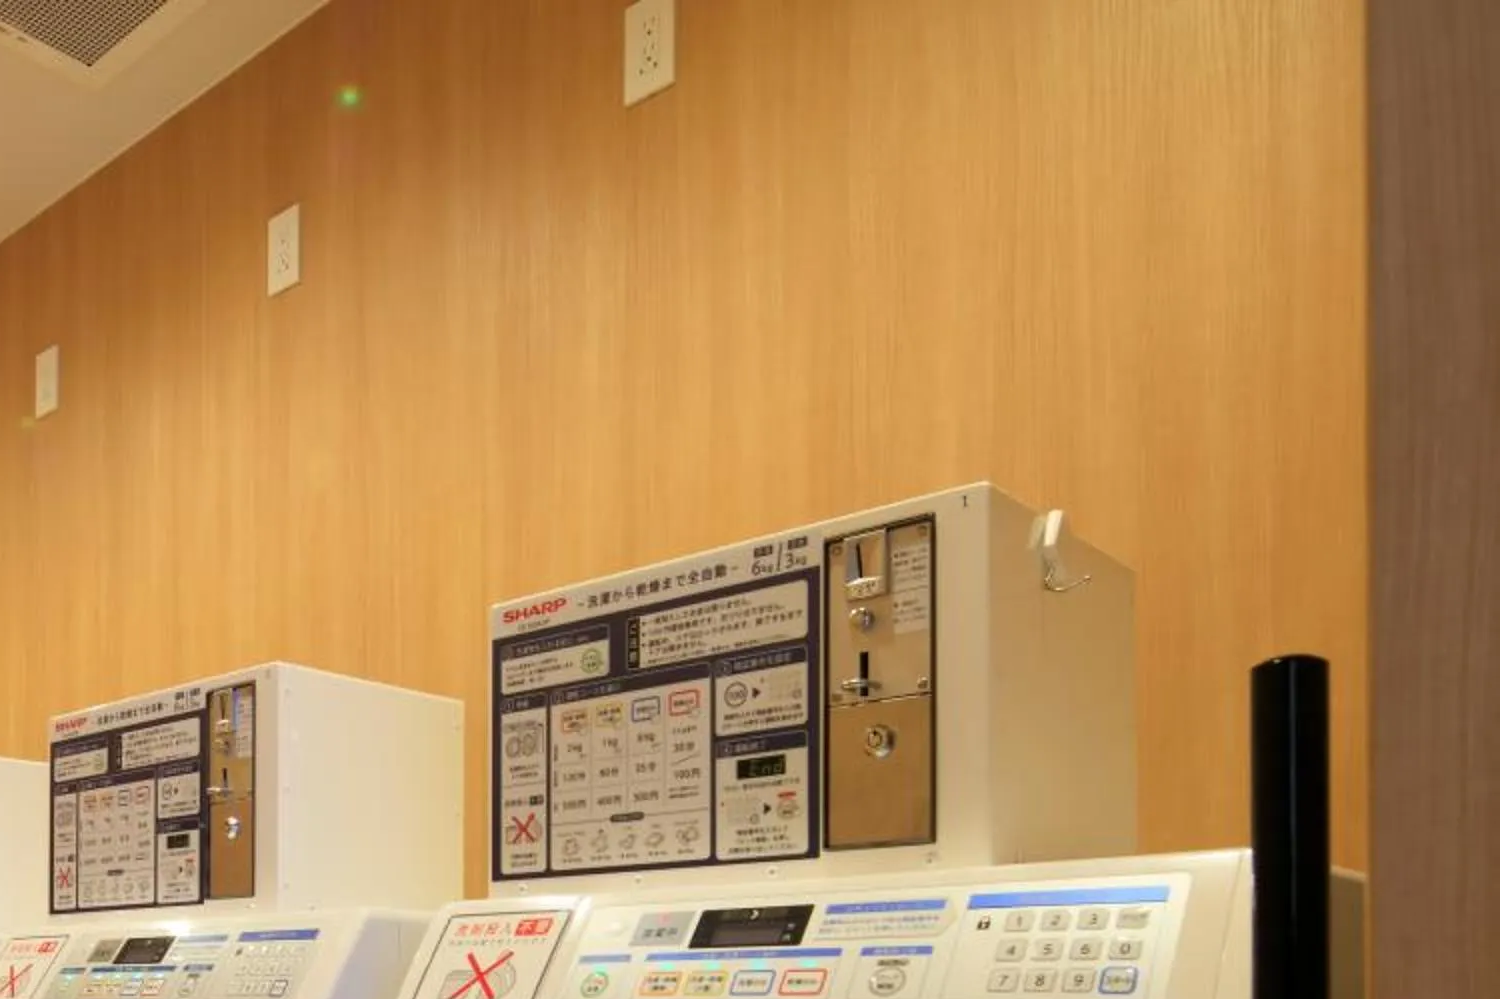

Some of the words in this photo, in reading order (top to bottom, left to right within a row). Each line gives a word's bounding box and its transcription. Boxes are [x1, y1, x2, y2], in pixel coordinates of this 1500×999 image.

[502, 597, 567, 623] SHARP
[1016, 916, 1022, 927] 1
[1051, 915, 1060, 926] 2
[1090, 914, 1098, 925] 3
[1007, 945, 1016, 956] 4
[1043, 944, 1052, 955] 5
[1080, 944, 1090, 955] 6
[1119, 943, 1131, 955] 0
[1000, 975, 1008, 987] 7
[1035, 975, 1045, 987] 8
[1073, 975, 1084, 987] 9
